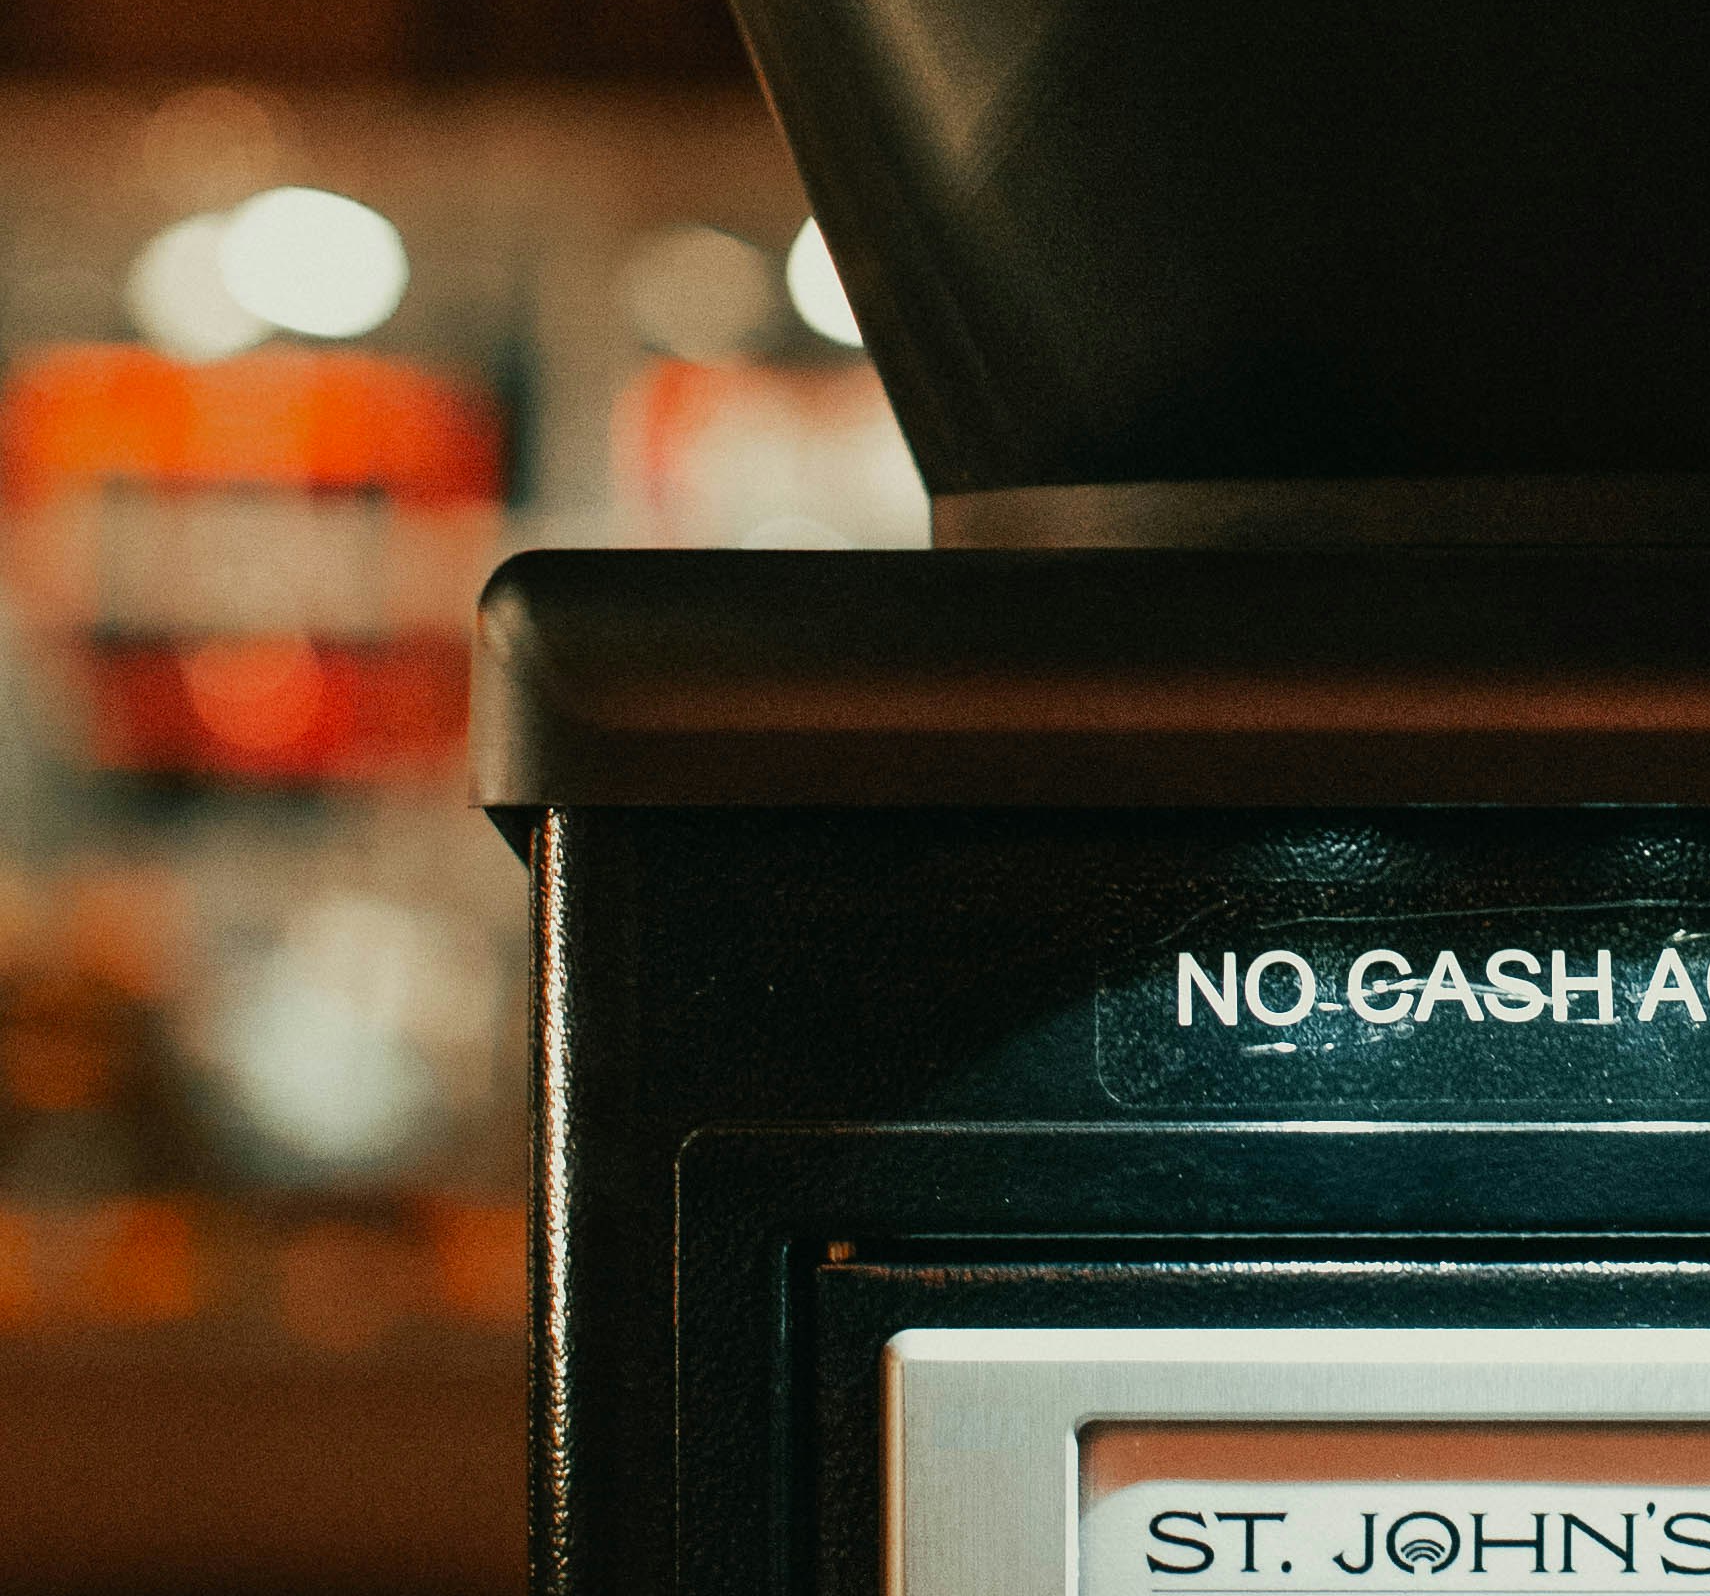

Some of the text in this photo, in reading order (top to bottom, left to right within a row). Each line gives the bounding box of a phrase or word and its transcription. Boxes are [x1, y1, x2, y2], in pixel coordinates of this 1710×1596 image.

[1177, 949, 1318, 1026] NO
[1347, 947, 1612, 1024] CASH
[1147, 1511, 1291, 1574] ST.
